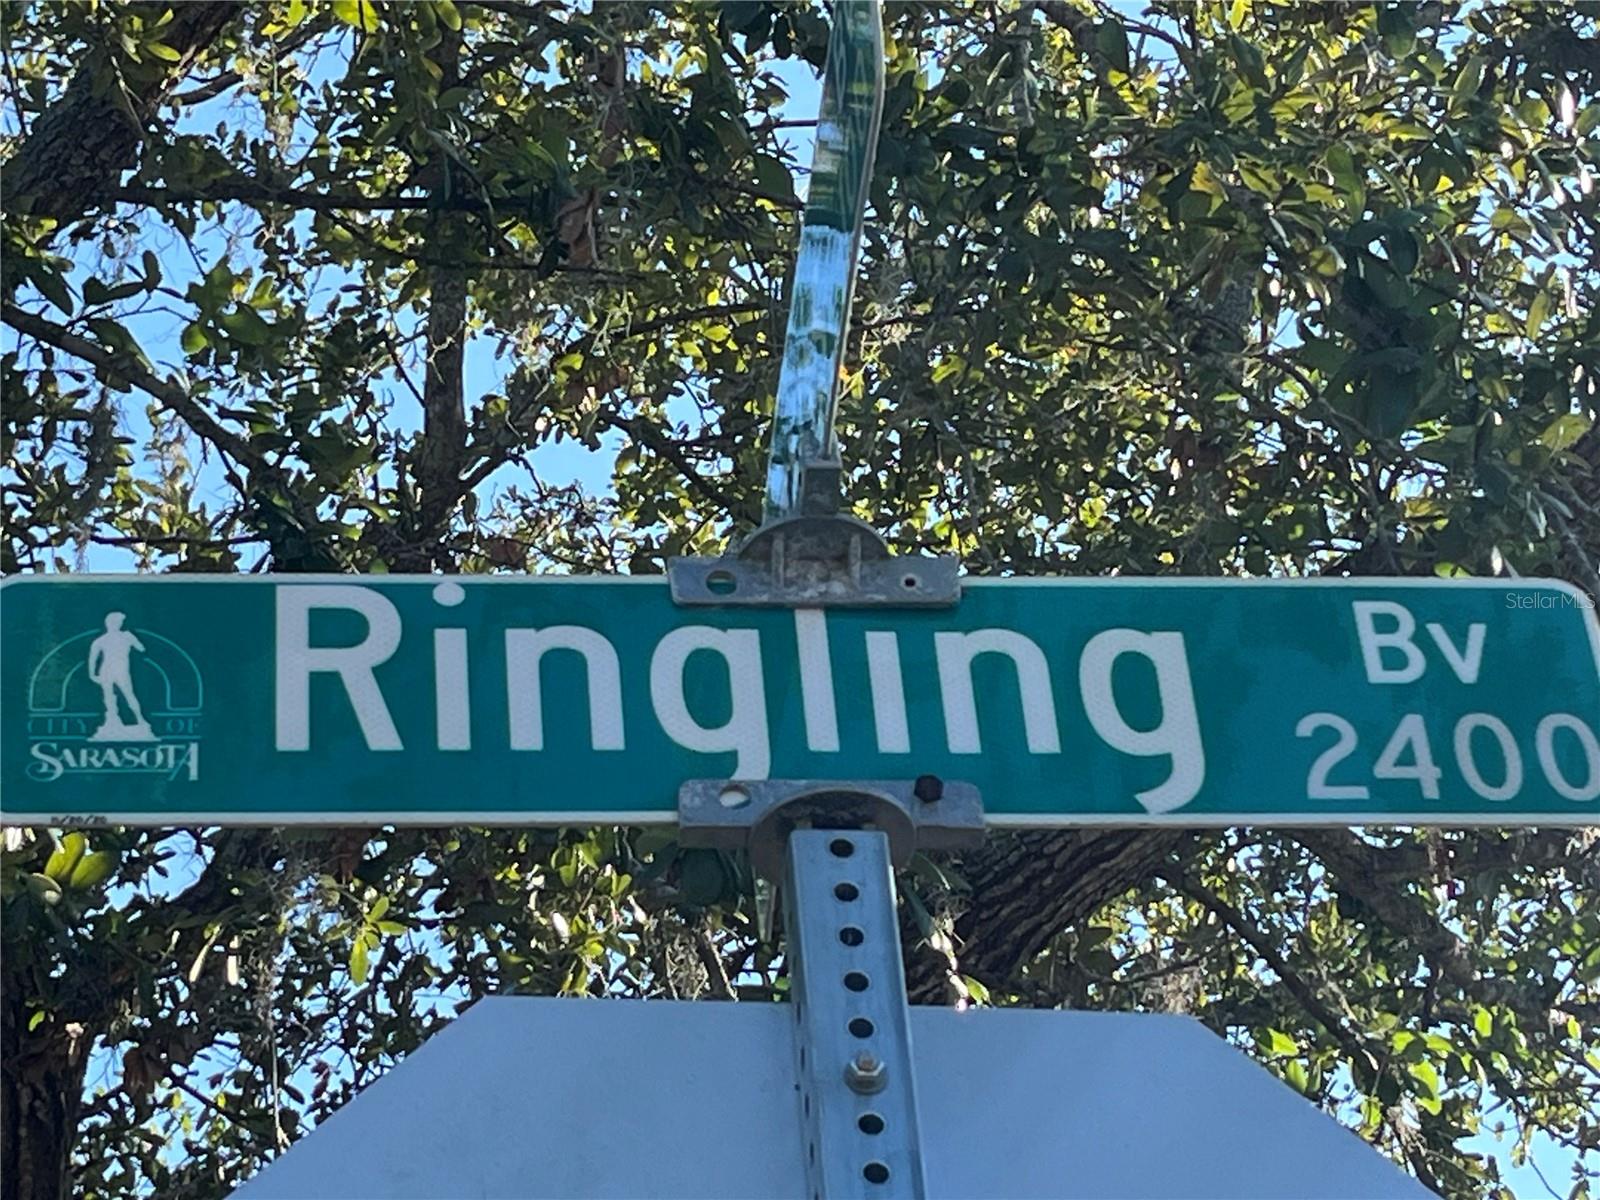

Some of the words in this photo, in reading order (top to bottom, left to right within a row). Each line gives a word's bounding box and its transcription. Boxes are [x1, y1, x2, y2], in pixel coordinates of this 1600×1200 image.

[1352, 600, 1487, 685] Bv
[166, 718, 199, 735] OF
[275, 584, 1206, 814] Ringling
[1296, 711, 1600, 802] 2400
